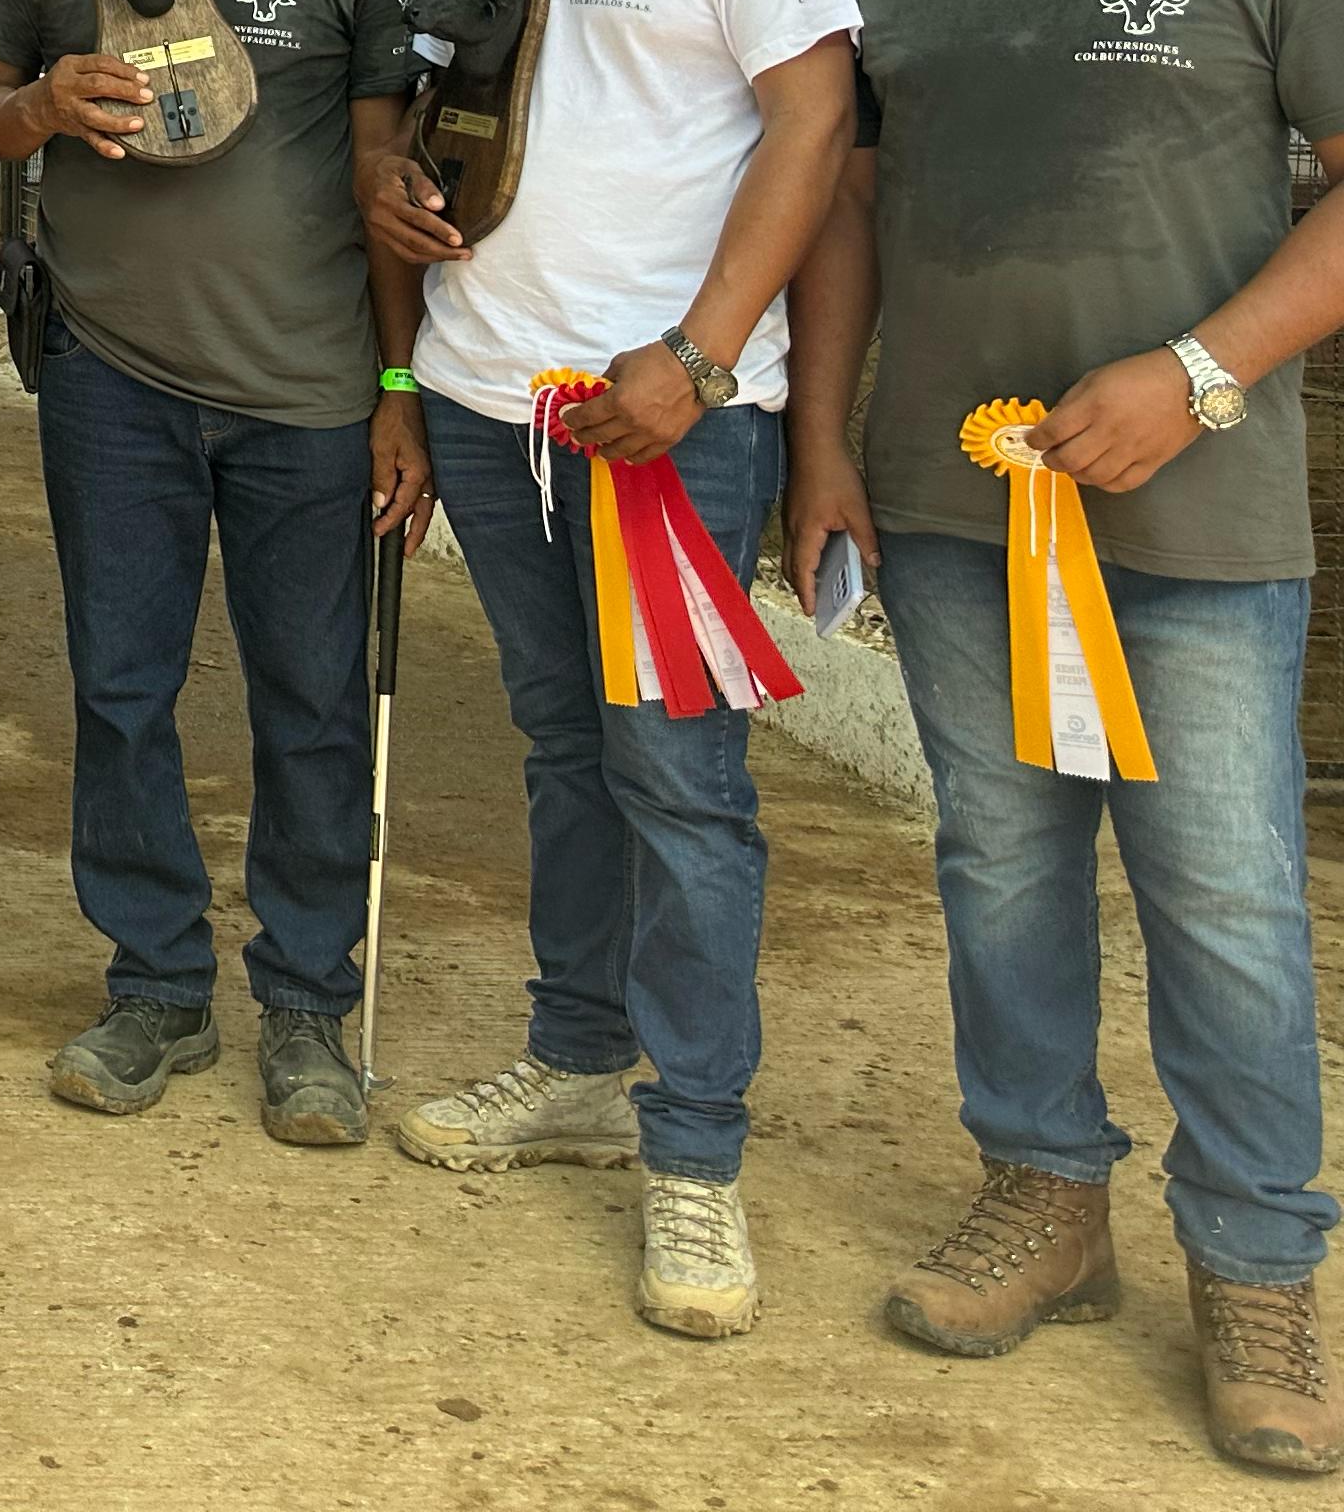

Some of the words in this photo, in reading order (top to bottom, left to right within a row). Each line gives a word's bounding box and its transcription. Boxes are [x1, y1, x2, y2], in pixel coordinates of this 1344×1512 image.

[625, 1, 652, 13] S.A.S.
[234, 25, 292, 38] NVERSIONES
[241, 35, 276, 47] UFALOS
[1093, 41, 1179, 55] INVERSIONES
[1074, 52, 1157, 64] COLBUFALOS
[1161, 56, 1195, 69] S.A.S.
